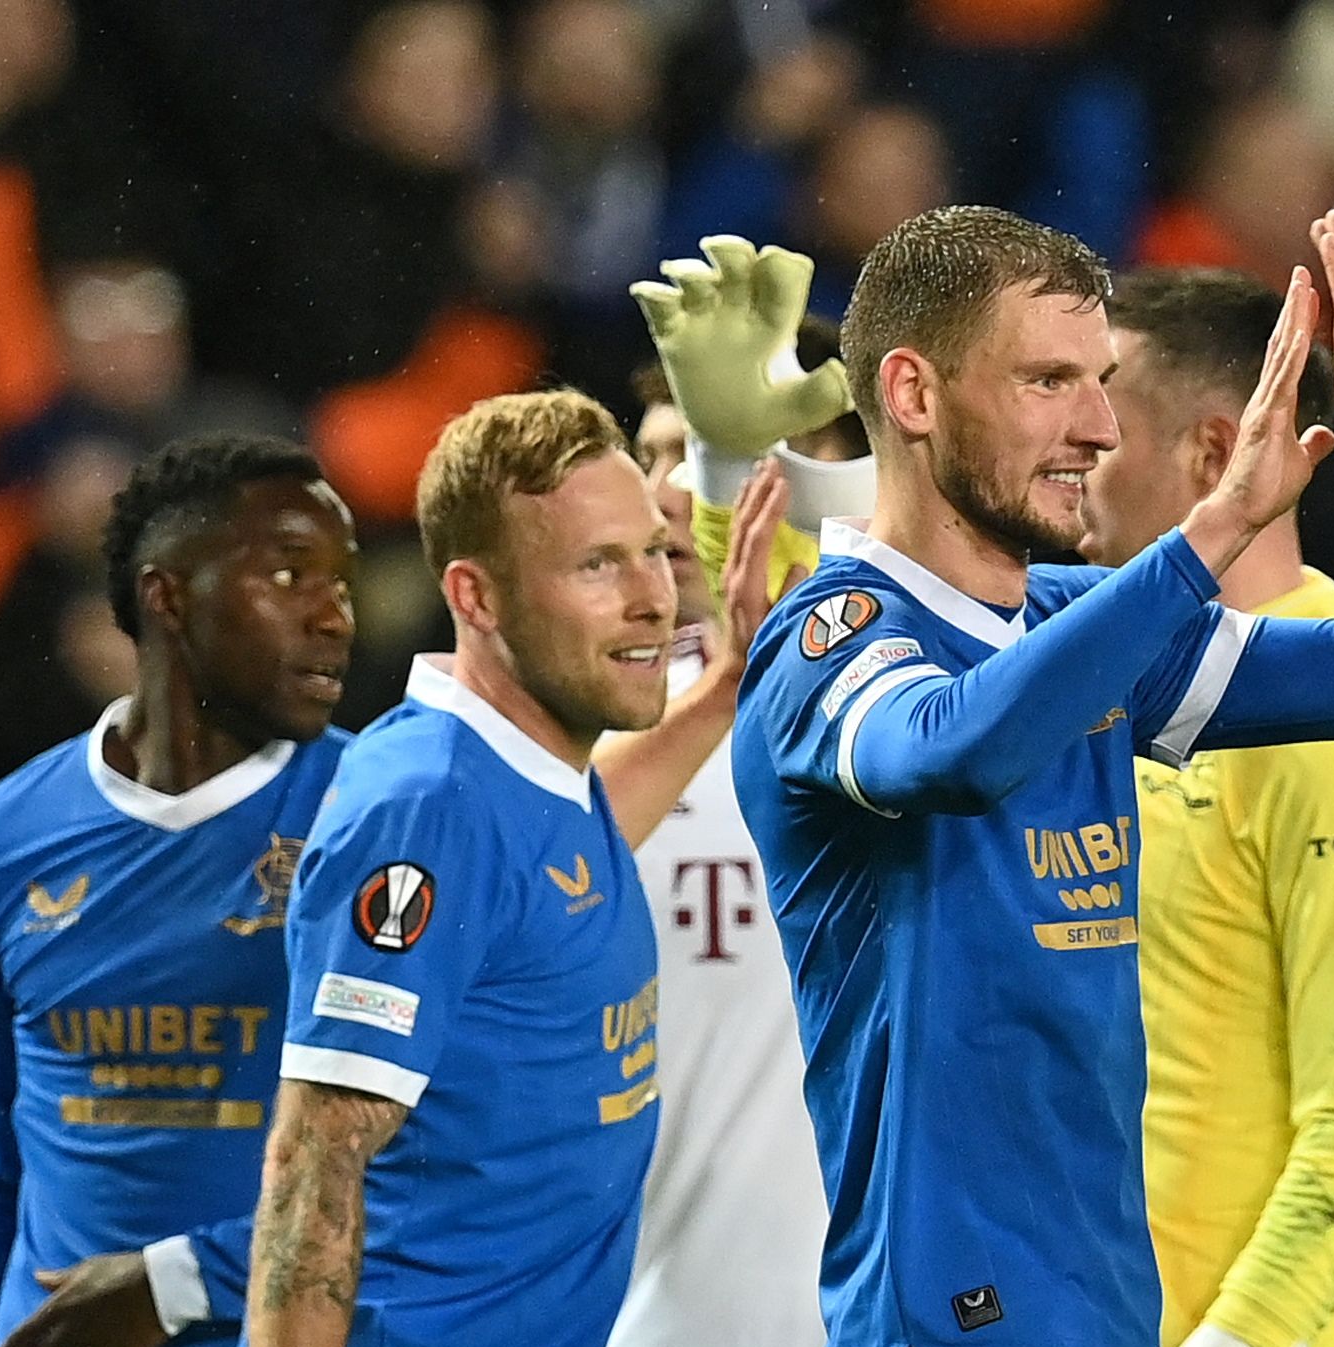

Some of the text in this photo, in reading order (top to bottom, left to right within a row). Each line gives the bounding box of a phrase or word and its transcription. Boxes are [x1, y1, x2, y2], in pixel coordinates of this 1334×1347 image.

[1024, 816, 1131, 879] UNIBT
[1066, 925, 1120, 943] SET YOU
[49, 1005, 269, 1054] UNIBET
